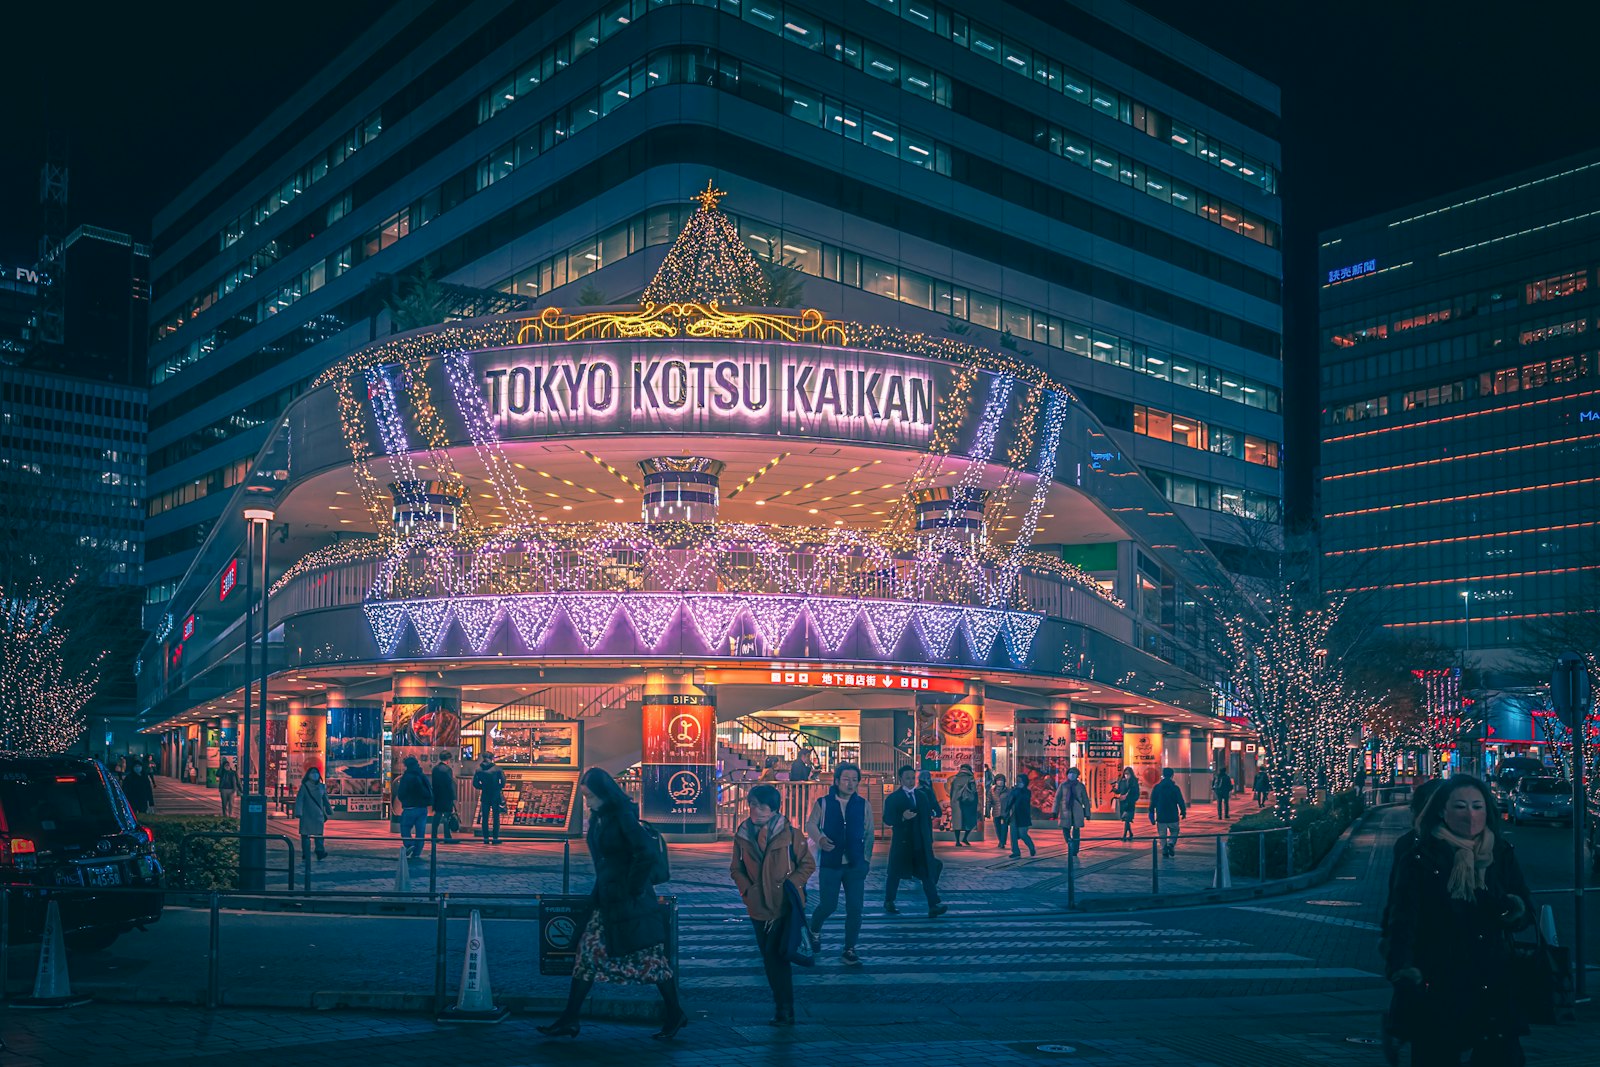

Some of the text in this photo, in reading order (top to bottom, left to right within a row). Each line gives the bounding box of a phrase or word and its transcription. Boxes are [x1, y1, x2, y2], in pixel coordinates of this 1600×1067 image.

[1329, 259, 1376, 282] 読売新聞
[486, 360, 933, 425] TOKYO KOTSU KAIKAN
[822, 673, 876, 686] 地下商店街
